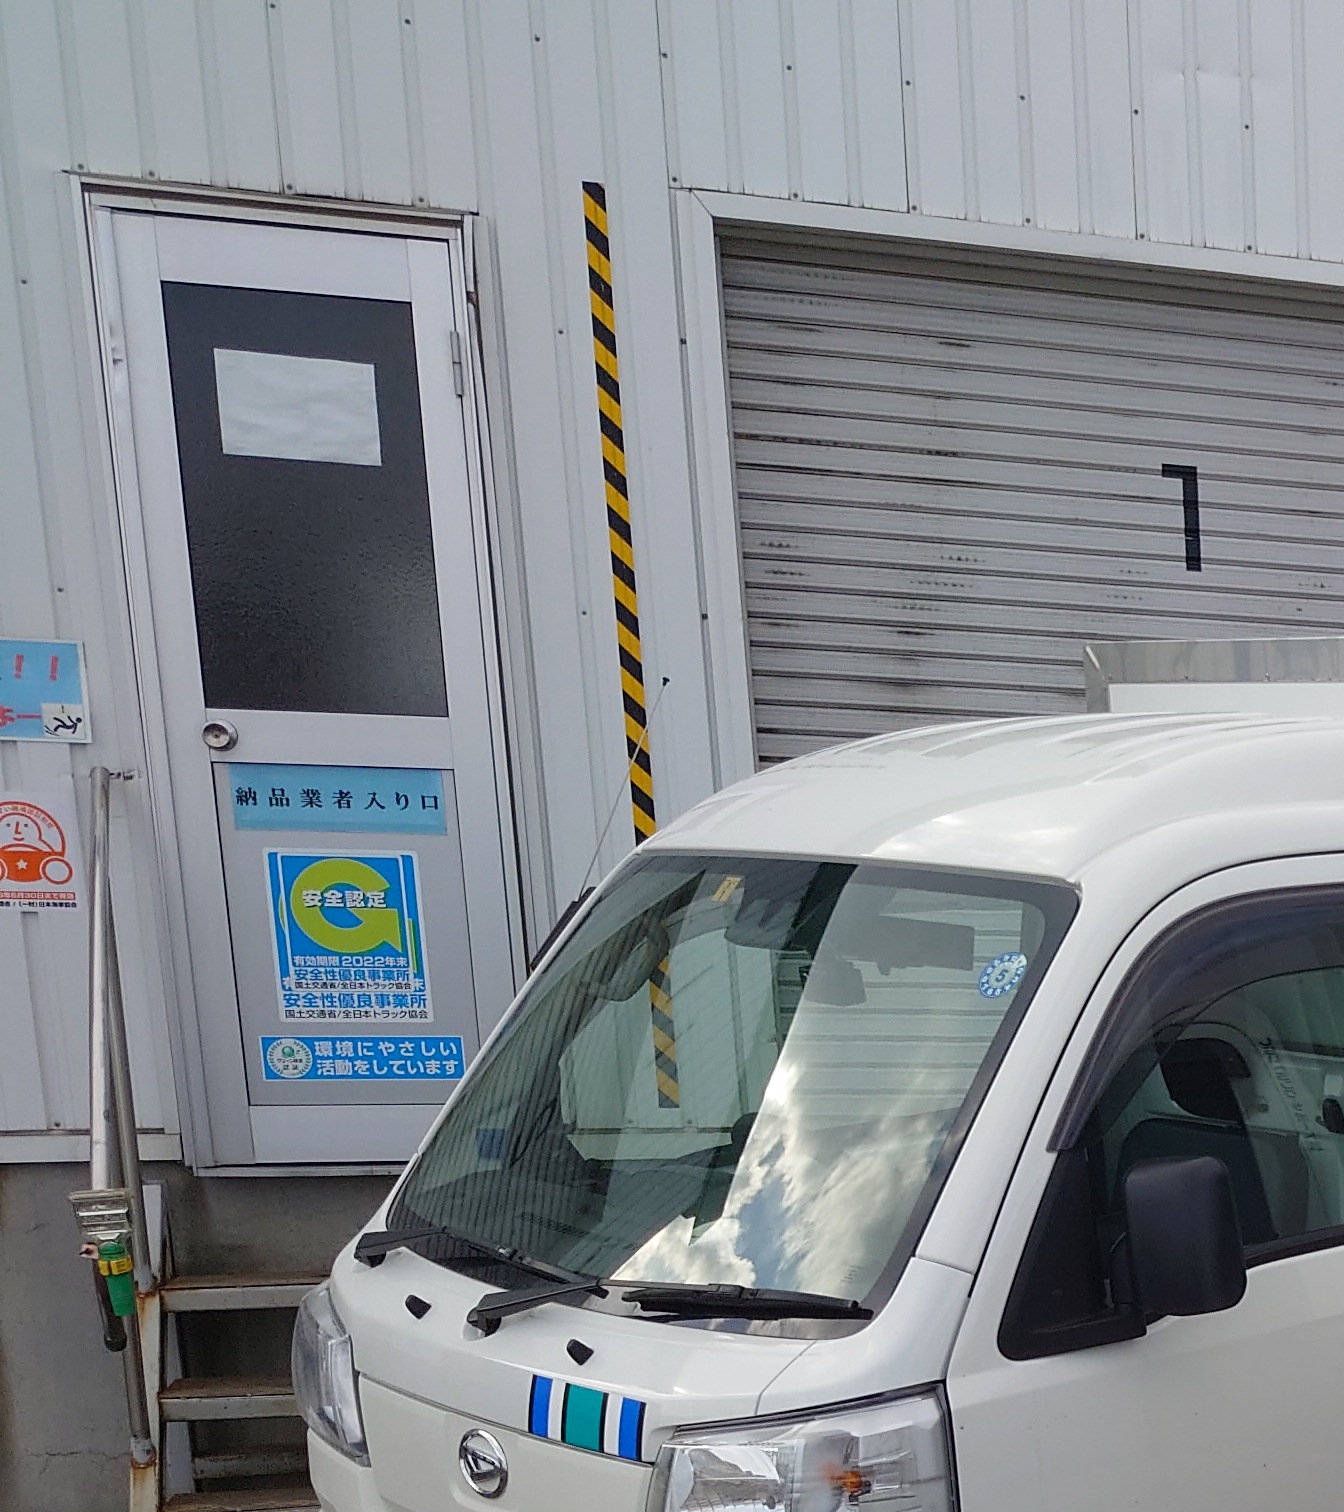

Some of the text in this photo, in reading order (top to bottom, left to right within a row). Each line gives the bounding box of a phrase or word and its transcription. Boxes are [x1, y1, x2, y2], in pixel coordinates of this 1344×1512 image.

[235, 786, 439, 810] 納品業者入り口
[302, 890, 387, 908] 安全認定
[295, 969, 410, 982] 安全性優良事業所
[995, 969, 1009, 982] 5
[283, 993, 427, 1009] 安全性優良事業所
[314, 1041, 457, 1057] 環境にやさしい
[316, 1060, 459, 1076] 活動をしています
